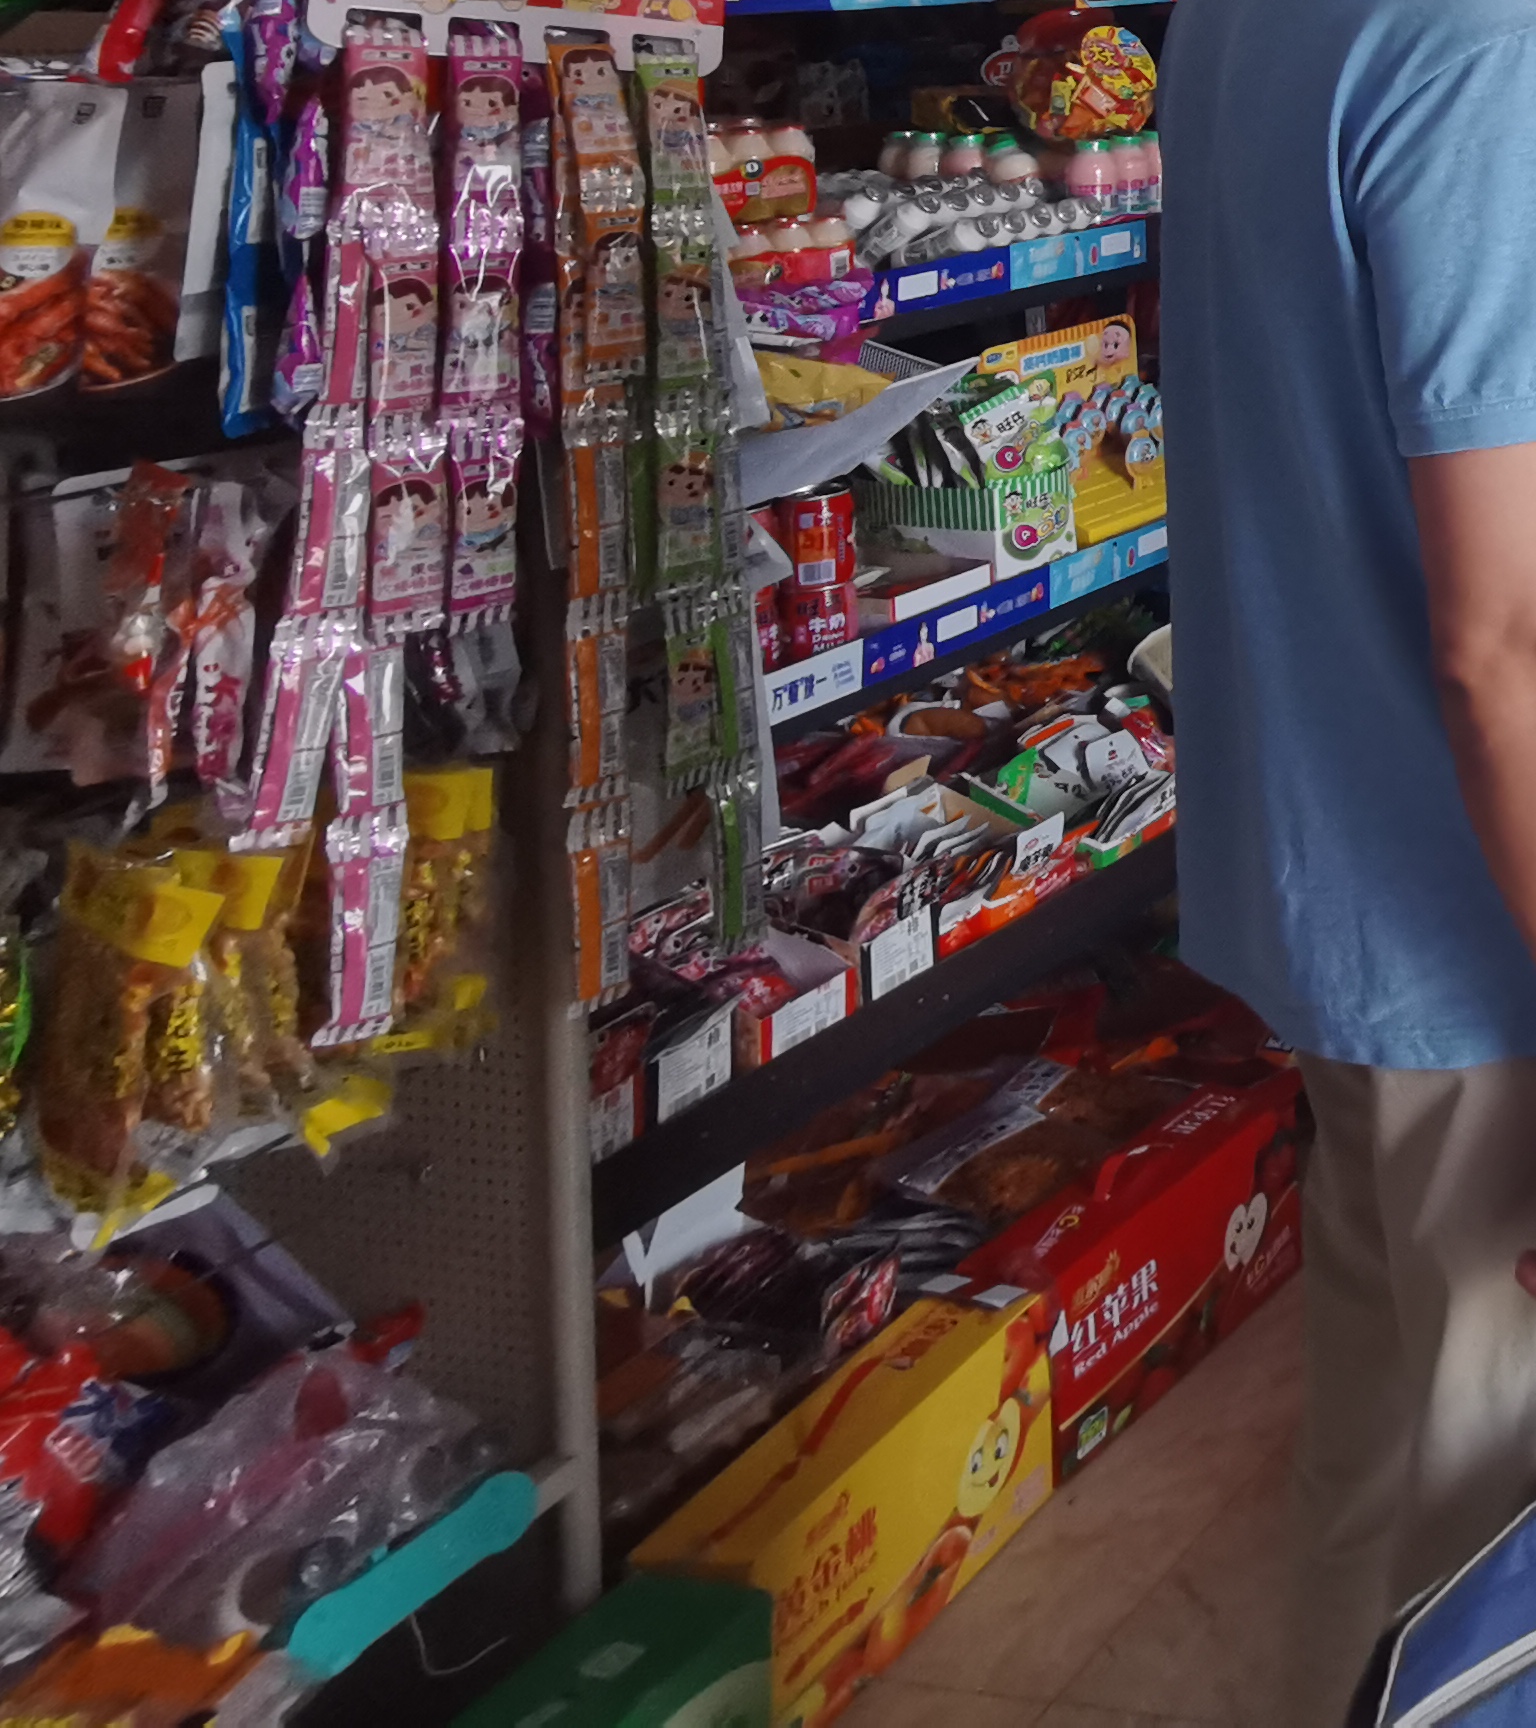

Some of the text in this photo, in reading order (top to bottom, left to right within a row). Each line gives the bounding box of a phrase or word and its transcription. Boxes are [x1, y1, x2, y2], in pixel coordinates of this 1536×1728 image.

[996, 411, 1025, 434] 旺仔
[809, 613, 845, 633] 牛奶
[1071, 1258, 1158, 1354] 红苹果
[1074, 1301, 1160, 1379] Red Apple
